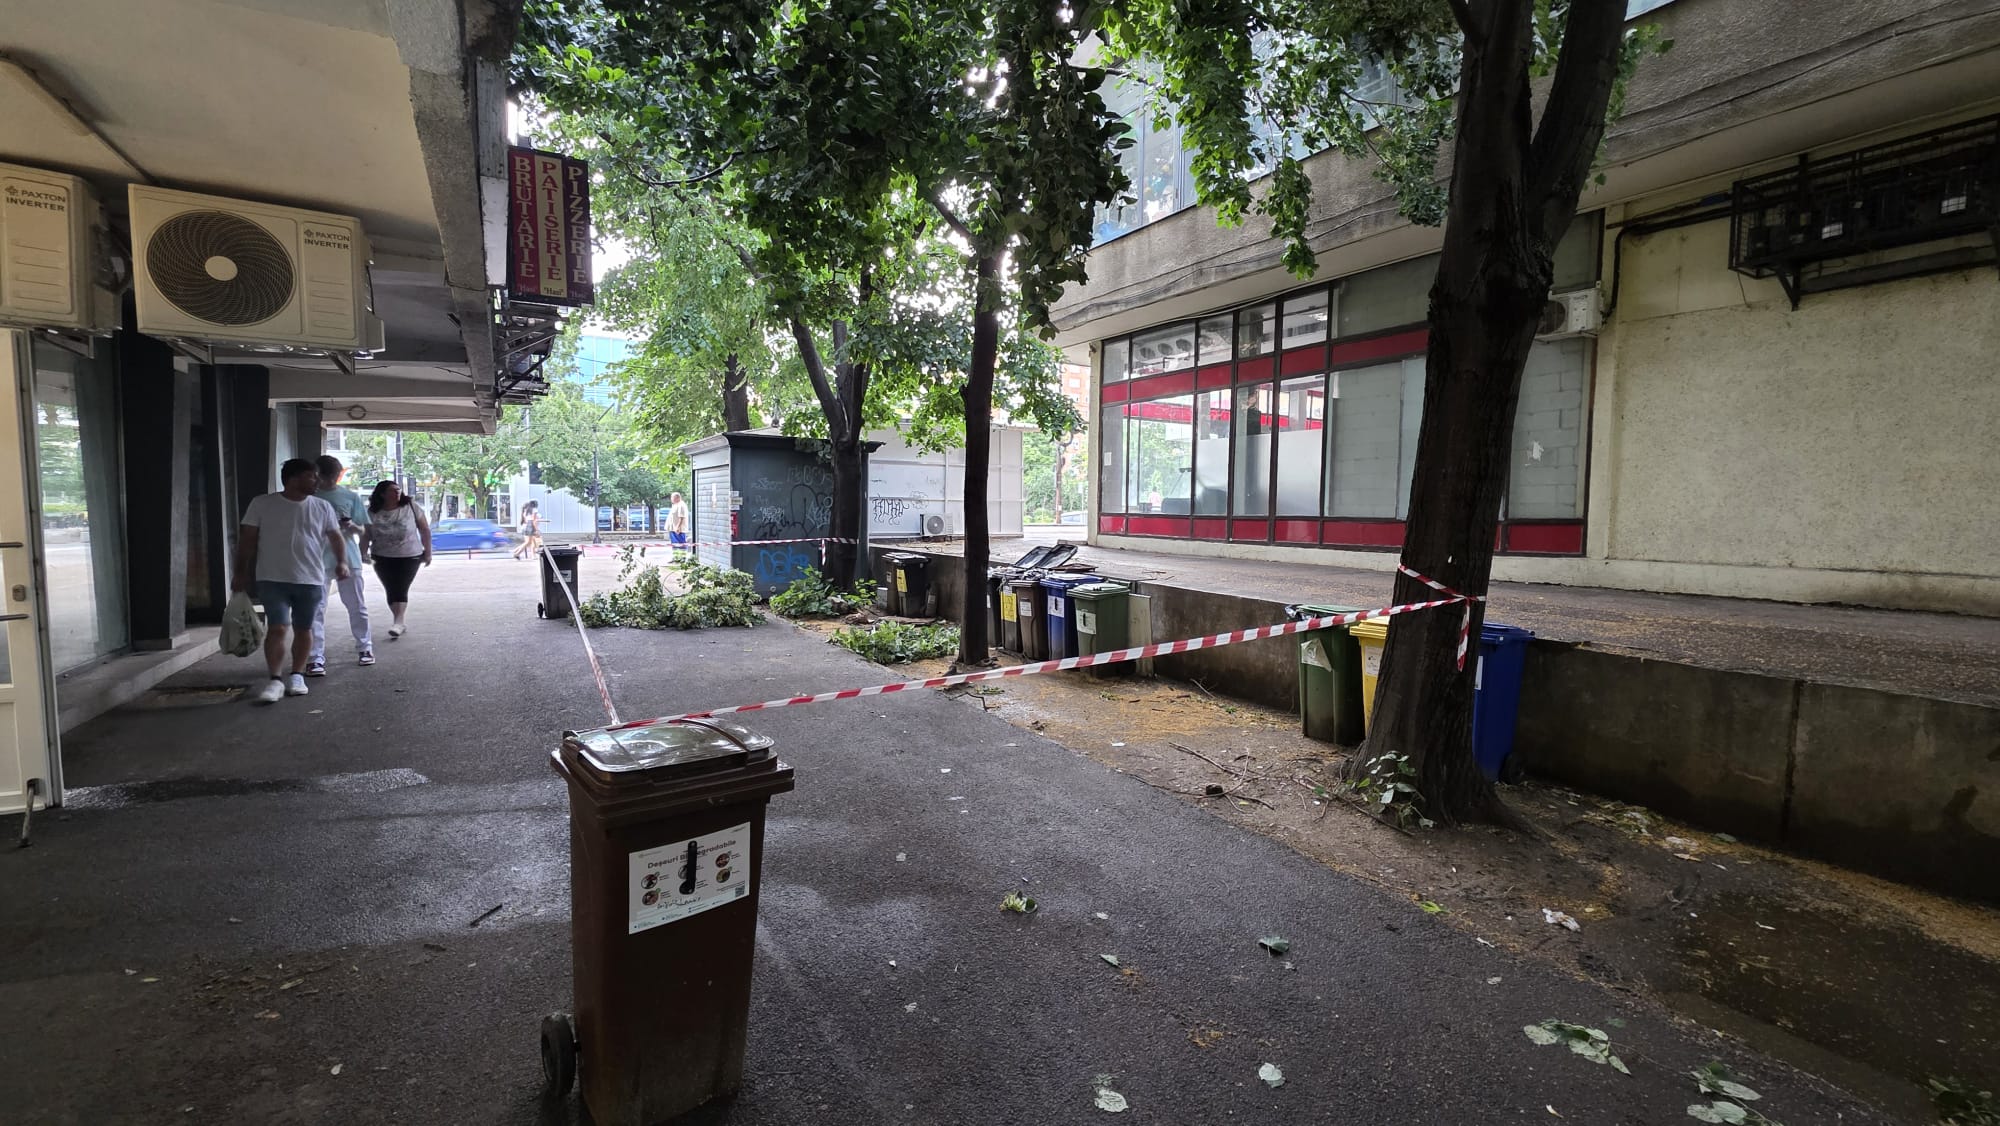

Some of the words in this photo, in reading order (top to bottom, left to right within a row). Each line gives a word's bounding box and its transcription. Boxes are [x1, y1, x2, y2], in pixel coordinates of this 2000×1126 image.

[6, 196, 65, 211] INVERTER
[21, 190, 66, 202] PAXTON
[514, 156, 536, 278] BRUTĂRIE
[541, 161, 562, 281] PATISERIE
[567, 166, 588, 285] PIZZERIE
[304, 238, 350, 250] INVERTER
[315, 231, 350, 242] PAXTON
